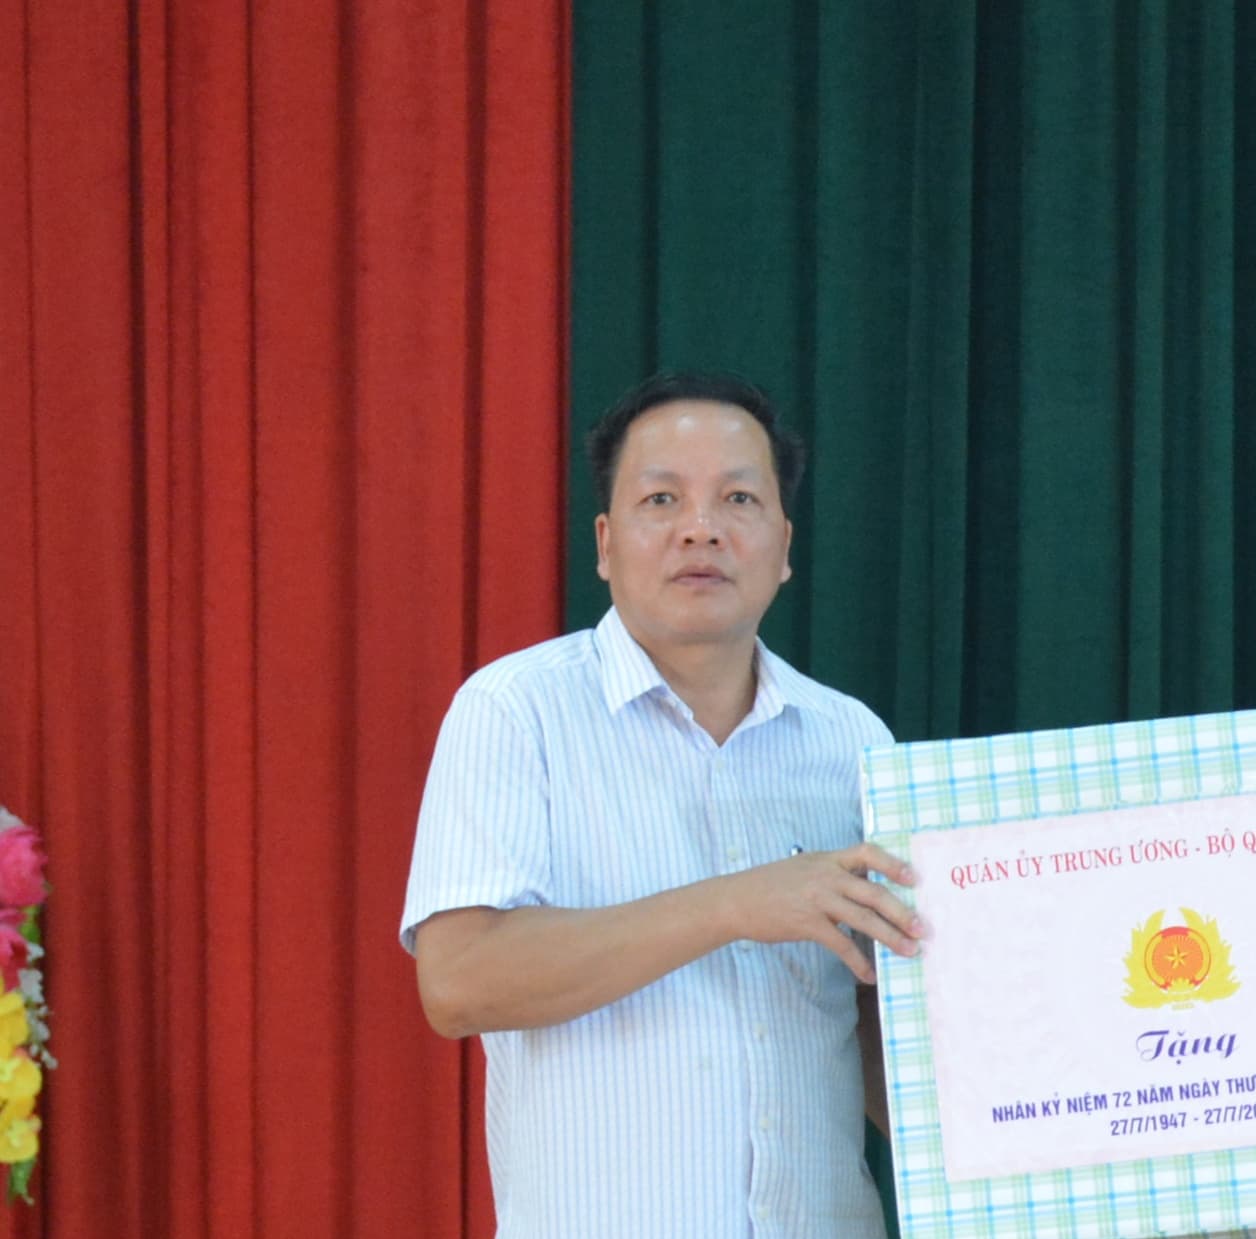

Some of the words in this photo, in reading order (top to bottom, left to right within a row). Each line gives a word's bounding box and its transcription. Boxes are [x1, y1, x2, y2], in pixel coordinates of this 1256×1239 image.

[1016, 849, 1043, 878] ỦY
[1050, 846, 1122, 874] TRUNG
[1129, 838, 1188, 864] ƯƠNG
[1206, 827, 1236, 858] BỘ
[1136, 1030, 1237, 1065] Tặng
[992, 1099, 1037, 1123] NHÂN
[1066, 1091, 1108, 1116] NIỆM
[1112, 1091, 1132, 1109] 72
[1178, 1077, 1220, 1099] NGÀY
[1110, 1111, 1187, 1137] 27/7/1947
